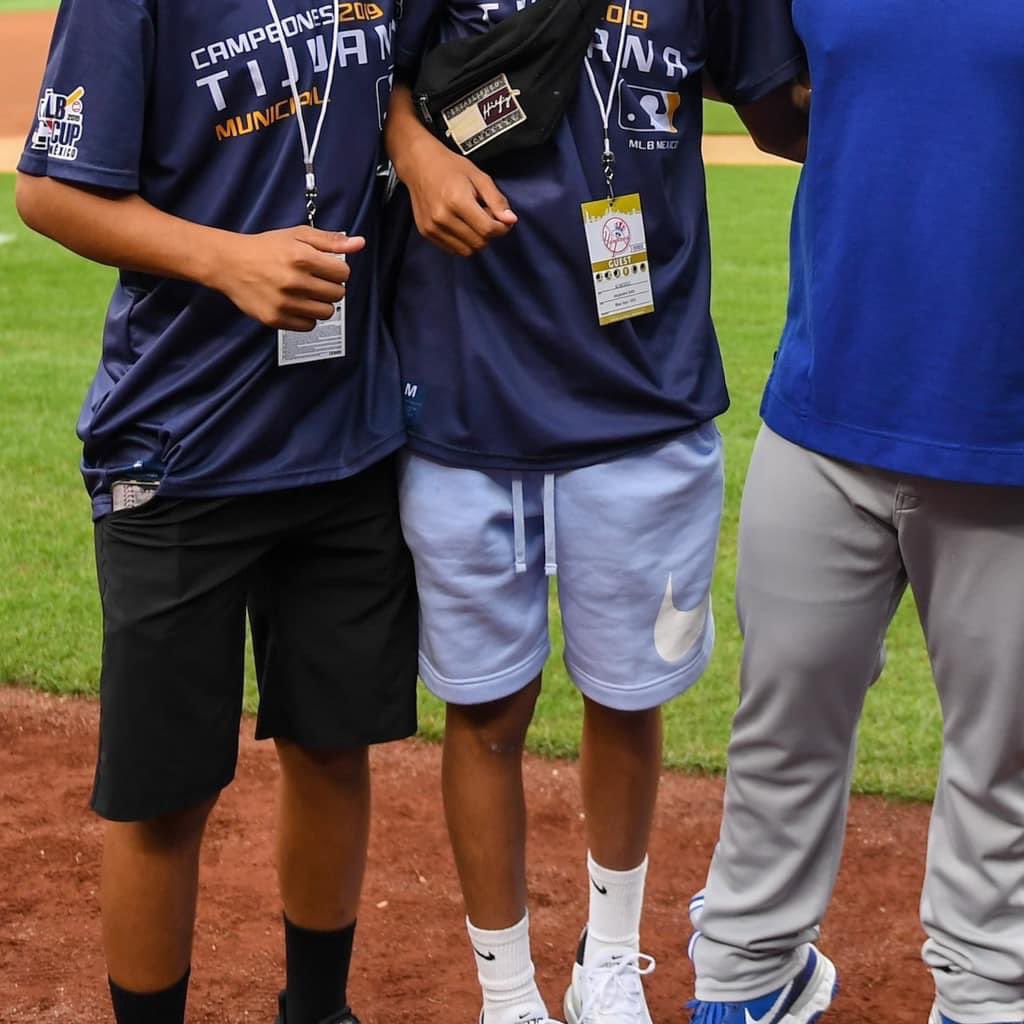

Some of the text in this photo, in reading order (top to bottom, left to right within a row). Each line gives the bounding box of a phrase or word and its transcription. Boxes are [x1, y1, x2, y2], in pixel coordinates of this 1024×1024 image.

[190, 3, 335, 71] CAMPEONES
[51, 120, 81, 147] CUP
[629, 139, 655, 150] MLB
[608, 255, 633, 269] GUEST
[404, 382, 418, 398] M
